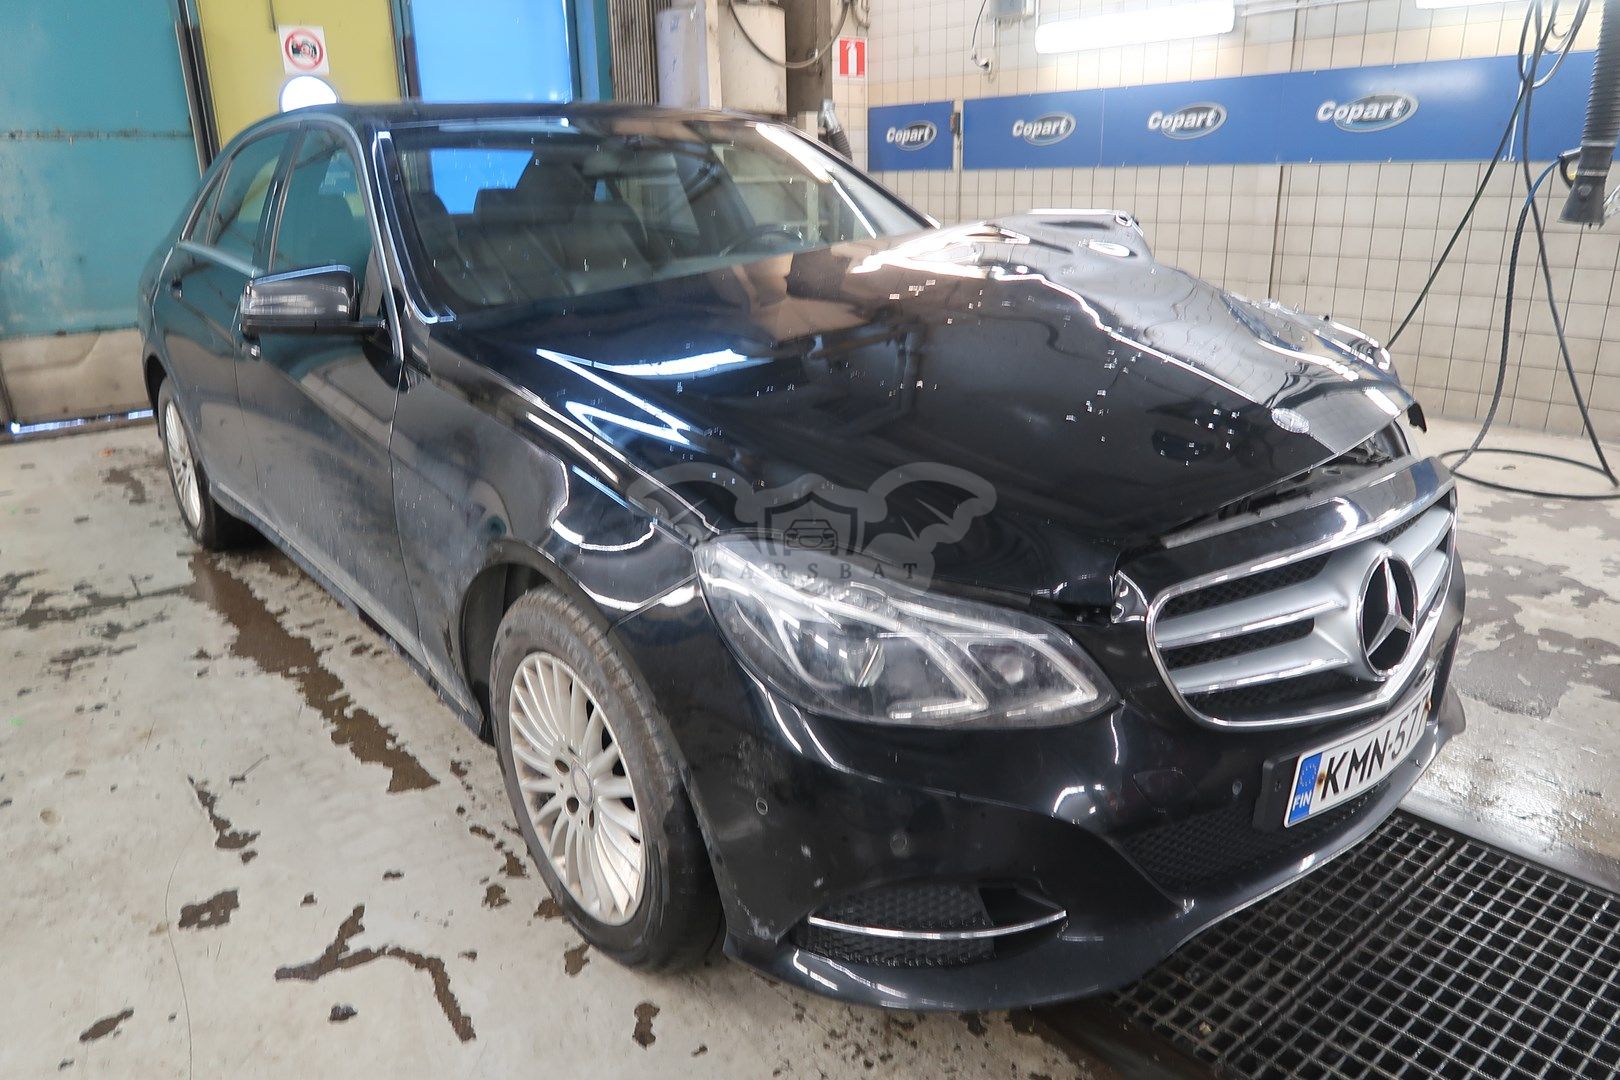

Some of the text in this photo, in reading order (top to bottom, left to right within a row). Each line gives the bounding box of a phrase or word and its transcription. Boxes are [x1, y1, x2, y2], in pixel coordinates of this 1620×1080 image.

[1147, 107, 1217, 132] Copart
[1316, 97, 1404, 124] Copart
[886, 125, 931, 145] Copart
[1012, 115, 1068, 141] Copart
[1321, 689, 1431, 800] KMN-577
[1292, 790, 1312, 811] FIN
